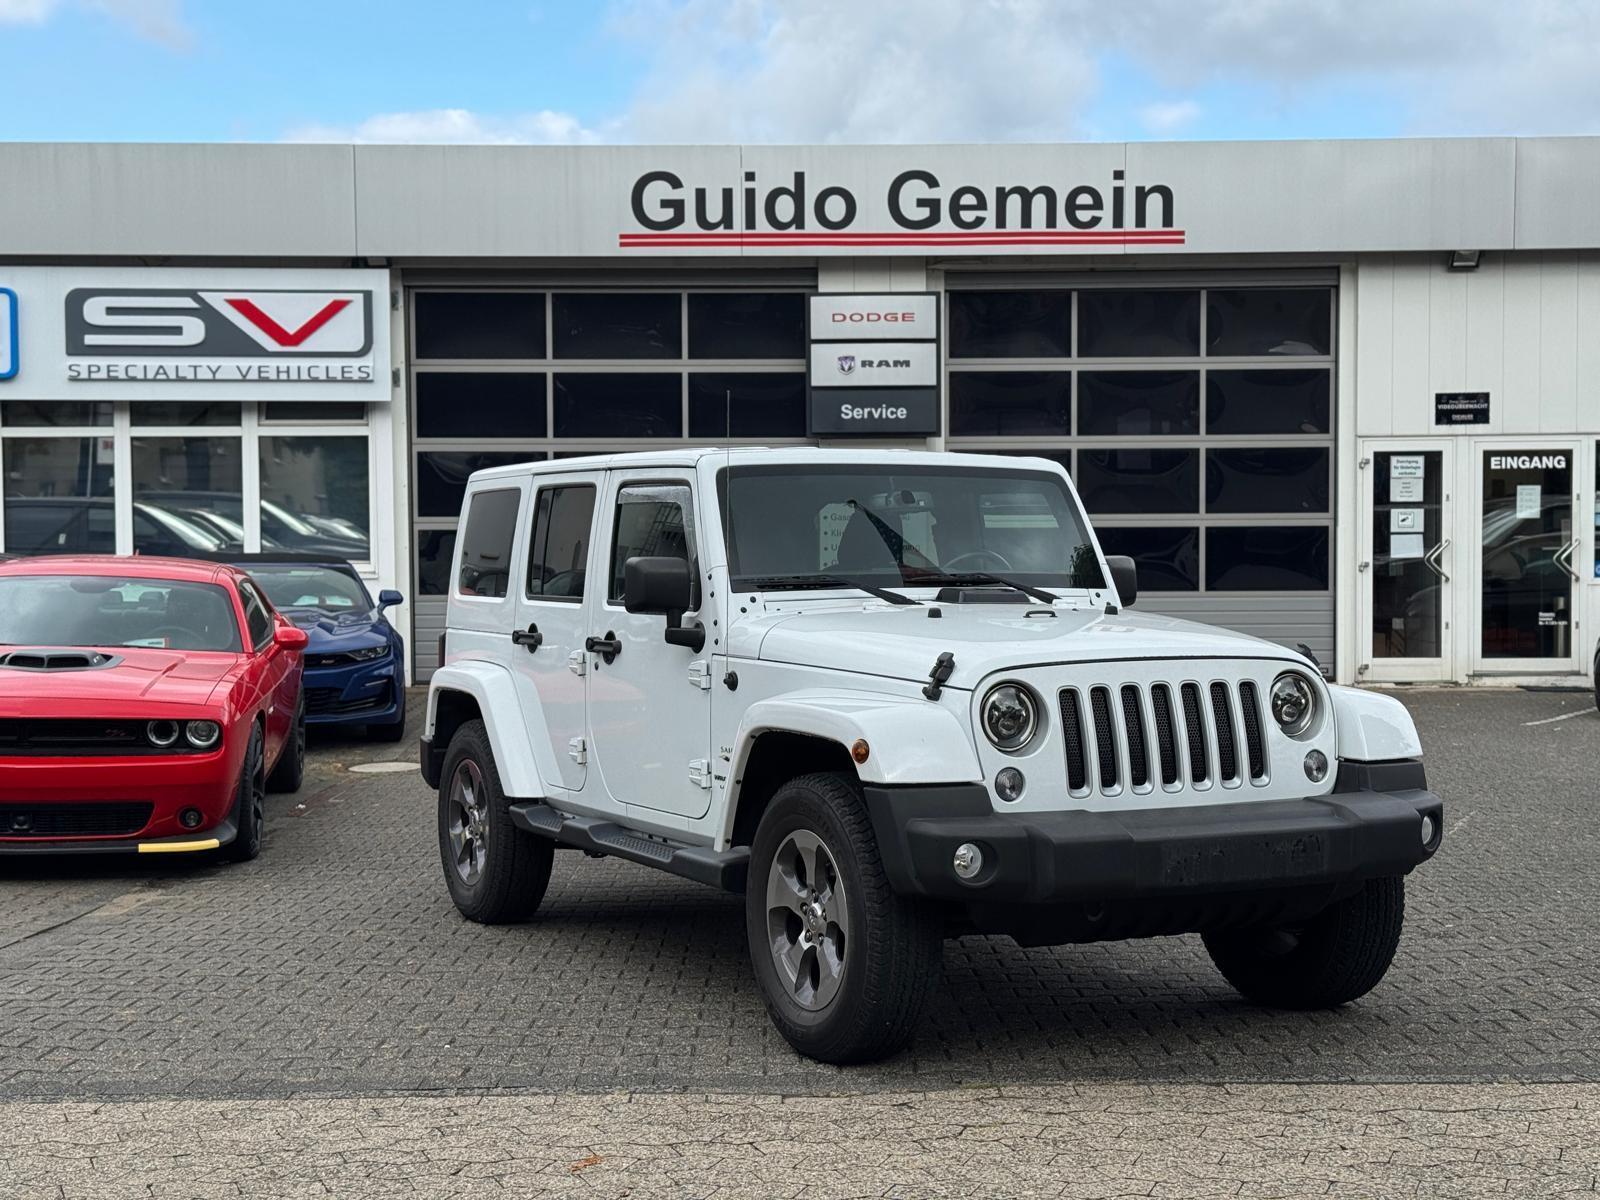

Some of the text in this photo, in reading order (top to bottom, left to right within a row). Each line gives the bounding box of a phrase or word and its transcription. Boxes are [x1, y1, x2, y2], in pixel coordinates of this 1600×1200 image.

[630, 169, 1175, 231] Guido Gemein
[82, 295, 354, 347] SV
[831, 312, 916, 323] DODGE
[68, 363, 372, 380] SPECIALTY VEHICLES
[860, 359, 911, 368] RAM
[840, 403, 908, 419] Service
[1490, 455, 1566, 470] EINGANG
